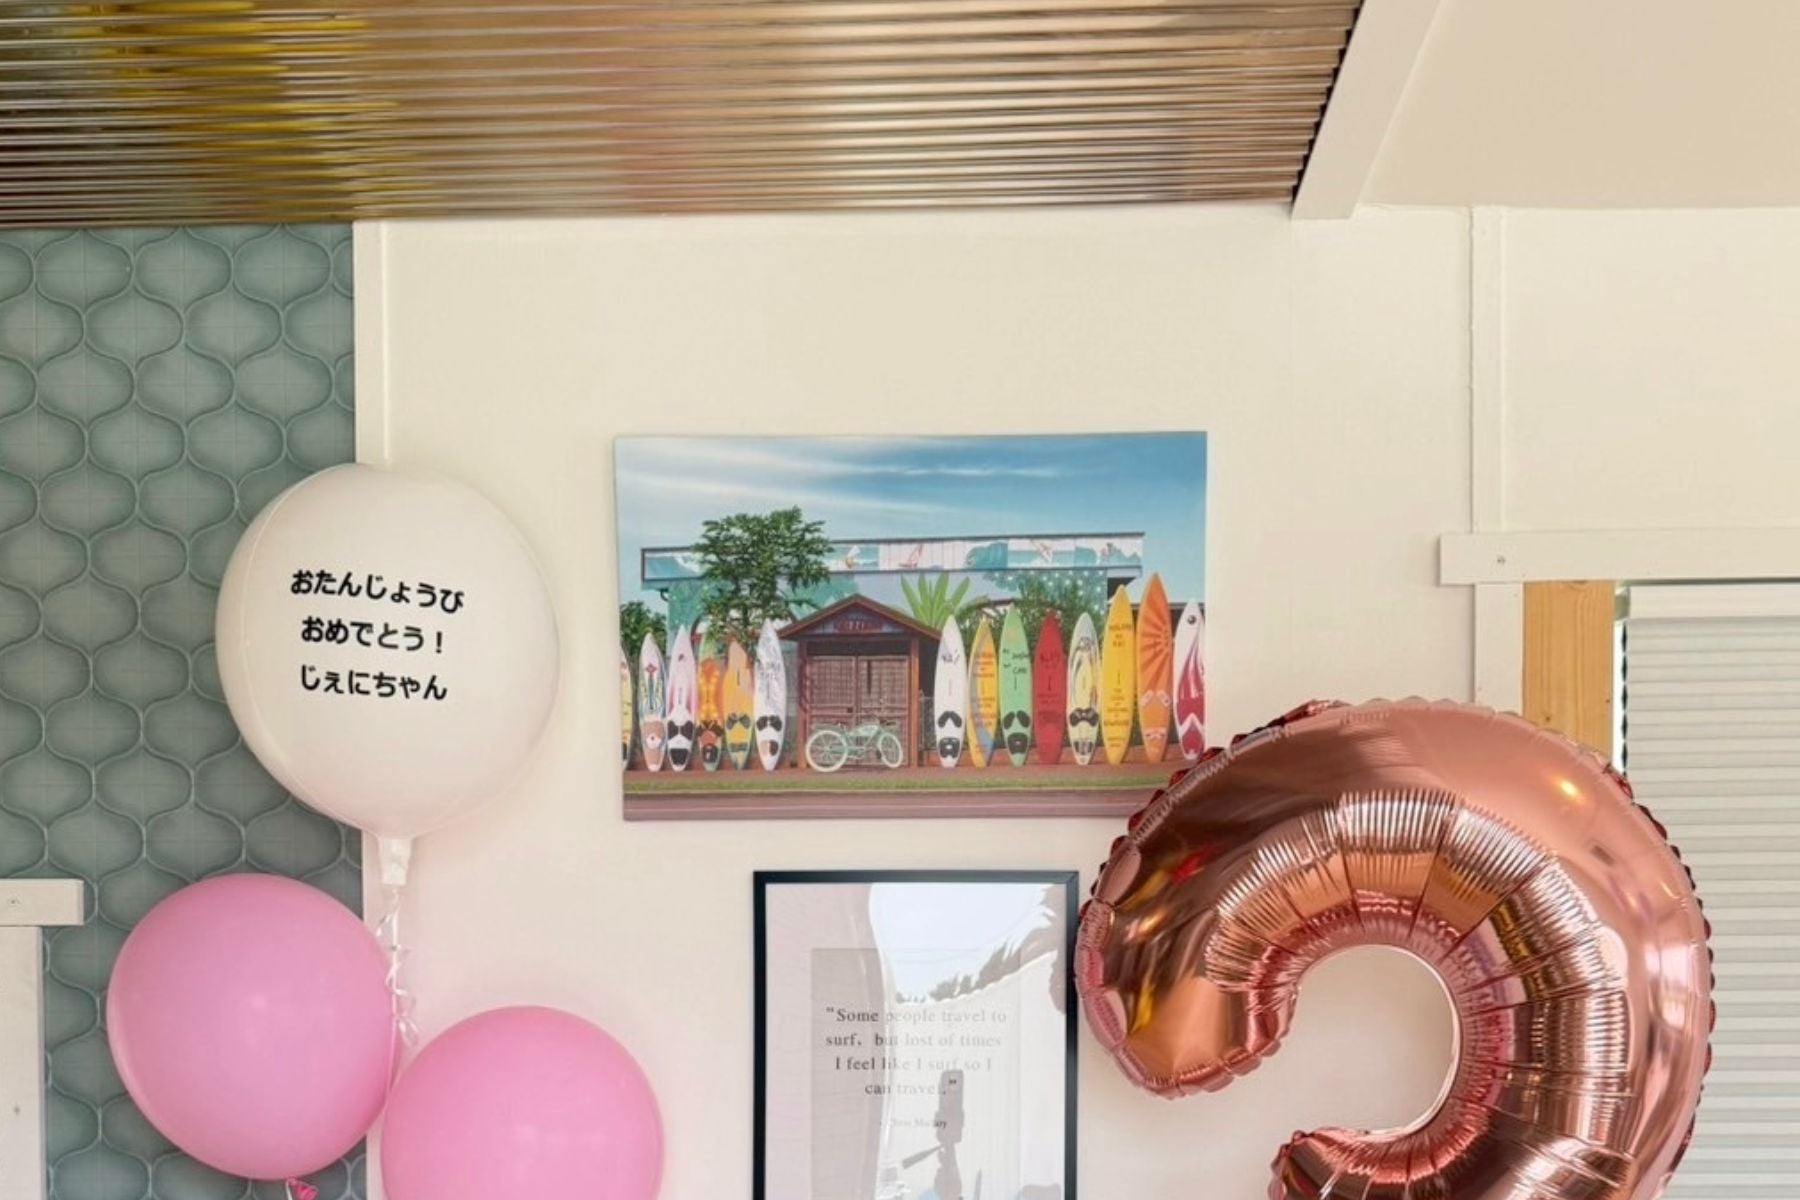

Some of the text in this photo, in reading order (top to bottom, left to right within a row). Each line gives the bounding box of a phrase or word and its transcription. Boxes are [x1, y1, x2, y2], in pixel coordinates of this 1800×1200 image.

[290, 569, 464, 613] おたんじょうび
[301, 664, 447, 701] じぇにちゃん
[886, 1009, 936, 1026] people
[942, 1008, 985, 1022] travel
[992, 1010, 1006, 1022] to
[875, 1032, 898, 1046] but
[905, 1032, 933, 1046] lost
[938, 1032, 956, 1046] of
[960, 1032, 1002, 1046] times
[835, 1056, 992, 1070] I feel like I surf so I
[865, 1084, 892, 1095] can
